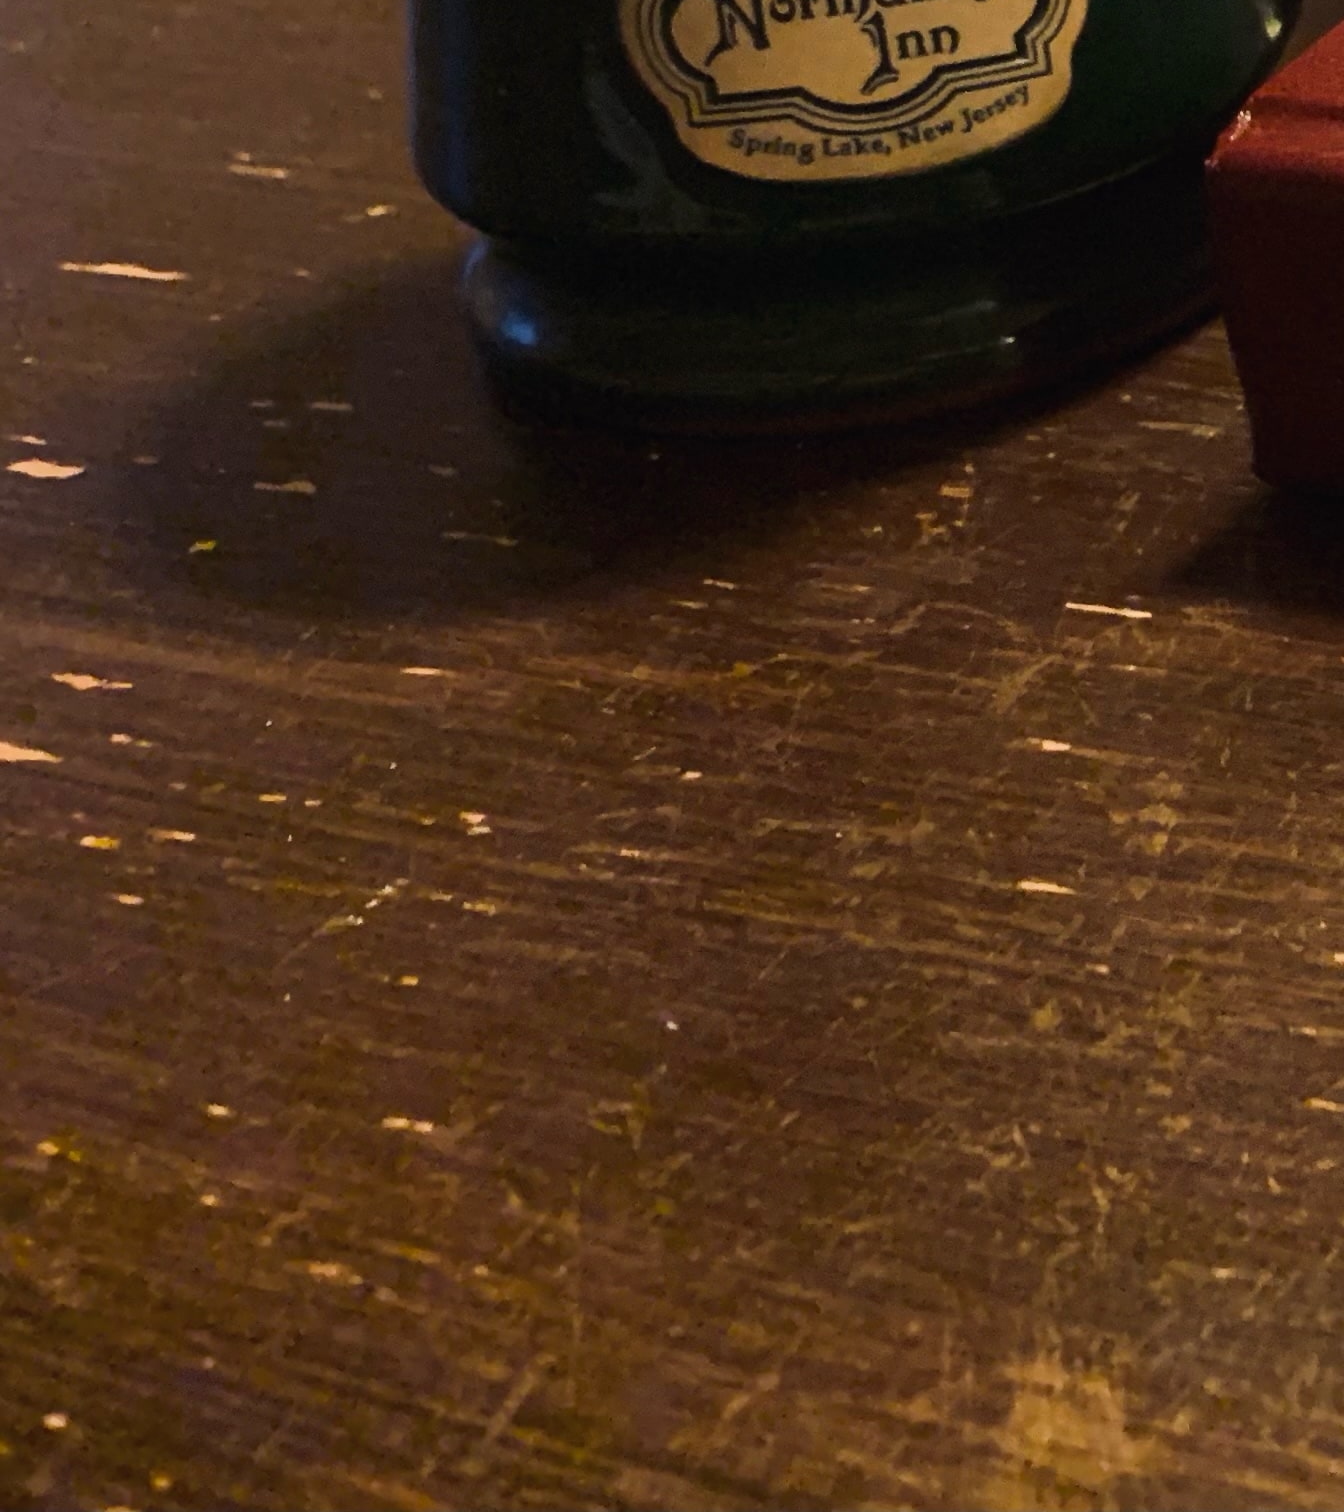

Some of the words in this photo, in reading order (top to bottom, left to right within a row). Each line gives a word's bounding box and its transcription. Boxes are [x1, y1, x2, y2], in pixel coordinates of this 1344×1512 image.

[860, 10, 961, 96] Inn
[727, 128, 816, 165] Spring
[822, 134, 892, 158] Lake,
[897, 119, 955, 149] New
[957, 84, 1031, 134] Jersey
